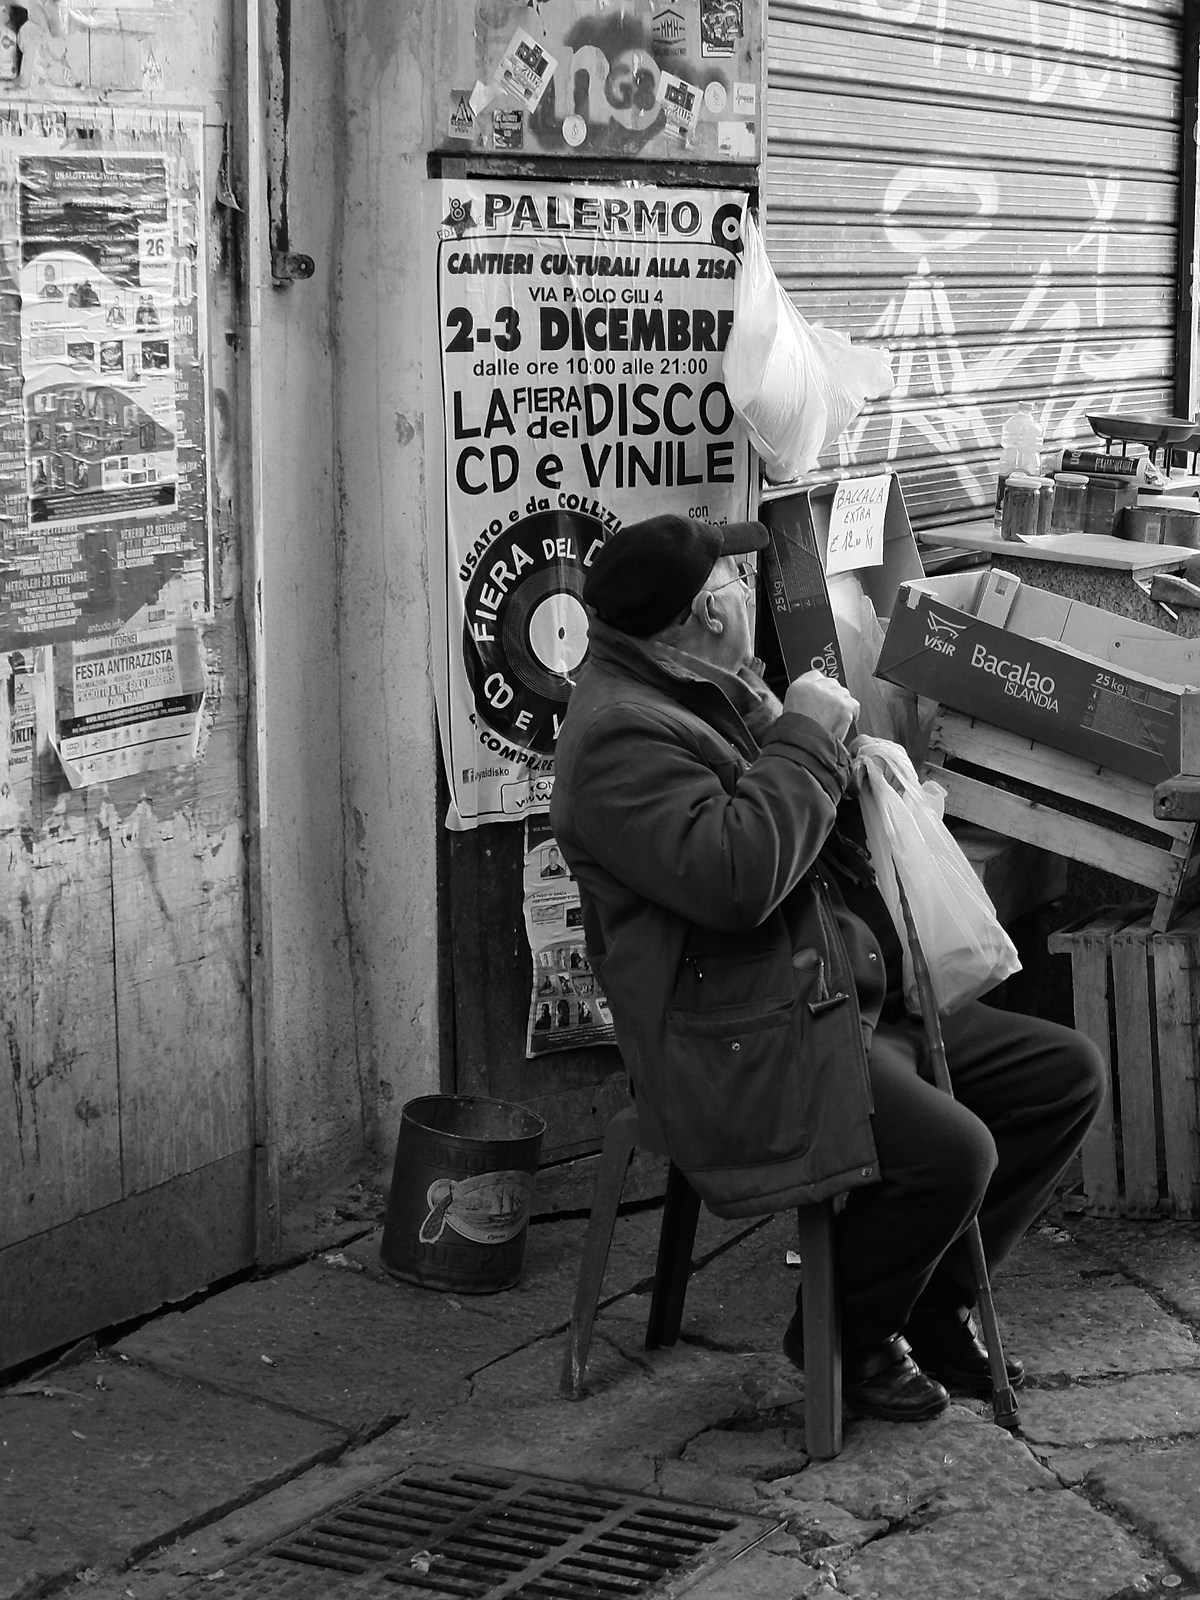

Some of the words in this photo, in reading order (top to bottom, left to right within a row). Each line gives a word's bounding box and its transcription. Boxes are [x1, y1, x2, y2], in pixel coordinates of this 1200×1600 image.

[484, 193, 702, 236] PALERMO
[145, 239, 165, 257] 26
[447, 253, 534, 275] CANTIERI
[541, 255, 640, 277] CULTURALI
[646, 257, 690, 279] ALLA
[696, 258, 736, 280] ZISA
[529, 287, 558, 302] VIA
[563, 287, 616, 303] PAOLO
[621, 289, 649, 303] GILI
[654, 290, 664, 303] 4
[446, 306, 521, 353] 2-3
[473, 359, 519, 376] dalle
[526, 362, 559, 376] ore
[567, 358, 615, 375] 10:00
[622, 359, 654, 375] alle
[660, 358, 708, 375] 21:00
[453, 388, 516, 440] LA
[513, 386, 583, 414] FIERA
[584, 382, 734, 437] DISCO
[526, 415, 578, 439] del
[456, 445, 520, 495] CD
[536, 453, 564, 490] e
[580, 441, 734, 489] VINILE
[688, 505, 709, 519] con
[844, 506, 870, 524] EXTRA
[458, 518, 503, 582] USATO
[508, 508, 520, 523] e
[526, 496, 550, 514] da
[829, 534, 839, 553] €
[473, 543, 535, 643] FIERA
[542, 538, 577, 560] DEL
[773, 581, 785, 597] kg
[775, 596, 787, 612] 25
[75, 662, 106, 681] FESTA
[107, 649, 173, 674] ANTIRAZZISTA
[823, 642, 840, 680] NDIA
[971, 643, 1056, 696] Bacalao
[1004, 681, 1059, 714] ISLANDIA
[1095, 673, 1111, 686] 25
[1111, 678, 1125, 696] kg
[484, 672, 514, 709] CD
[515, 710, 534, 731] E
[480, 731, 555, 772] COMPRARE
